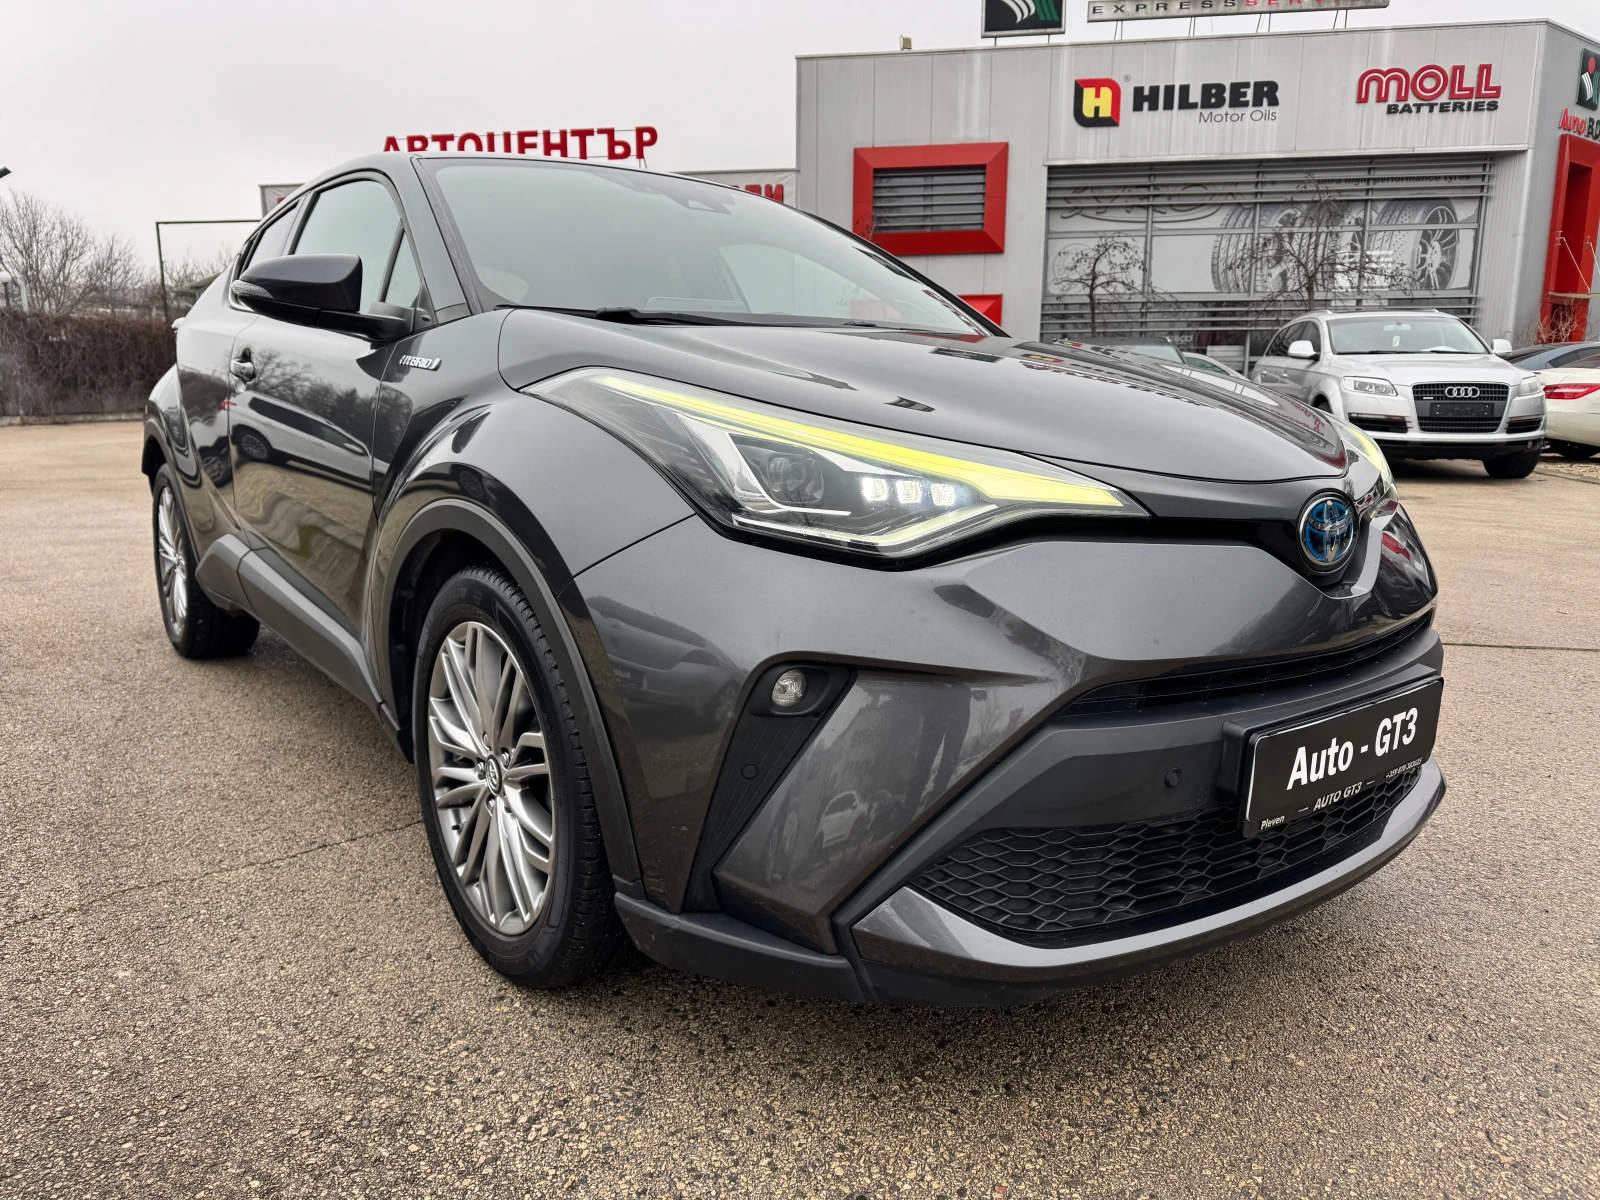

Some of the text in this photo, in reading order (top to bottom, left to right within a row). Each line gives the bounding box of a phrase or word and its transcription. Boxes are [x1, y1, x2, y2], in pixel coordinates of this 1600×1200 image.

[1133, 80, 1280, 112] HILBER
[1386, 100, 1499, 114] BATTERIES
[1199, 109, 1277, 123] Motor Oils
[1287, 737, 1353, 790] Auto
[1375, 707, 1418, 757] GT3
[1313, 782, 1362, 811] AUTO GT3
[1260, 815, 1285, 830] Pleven
